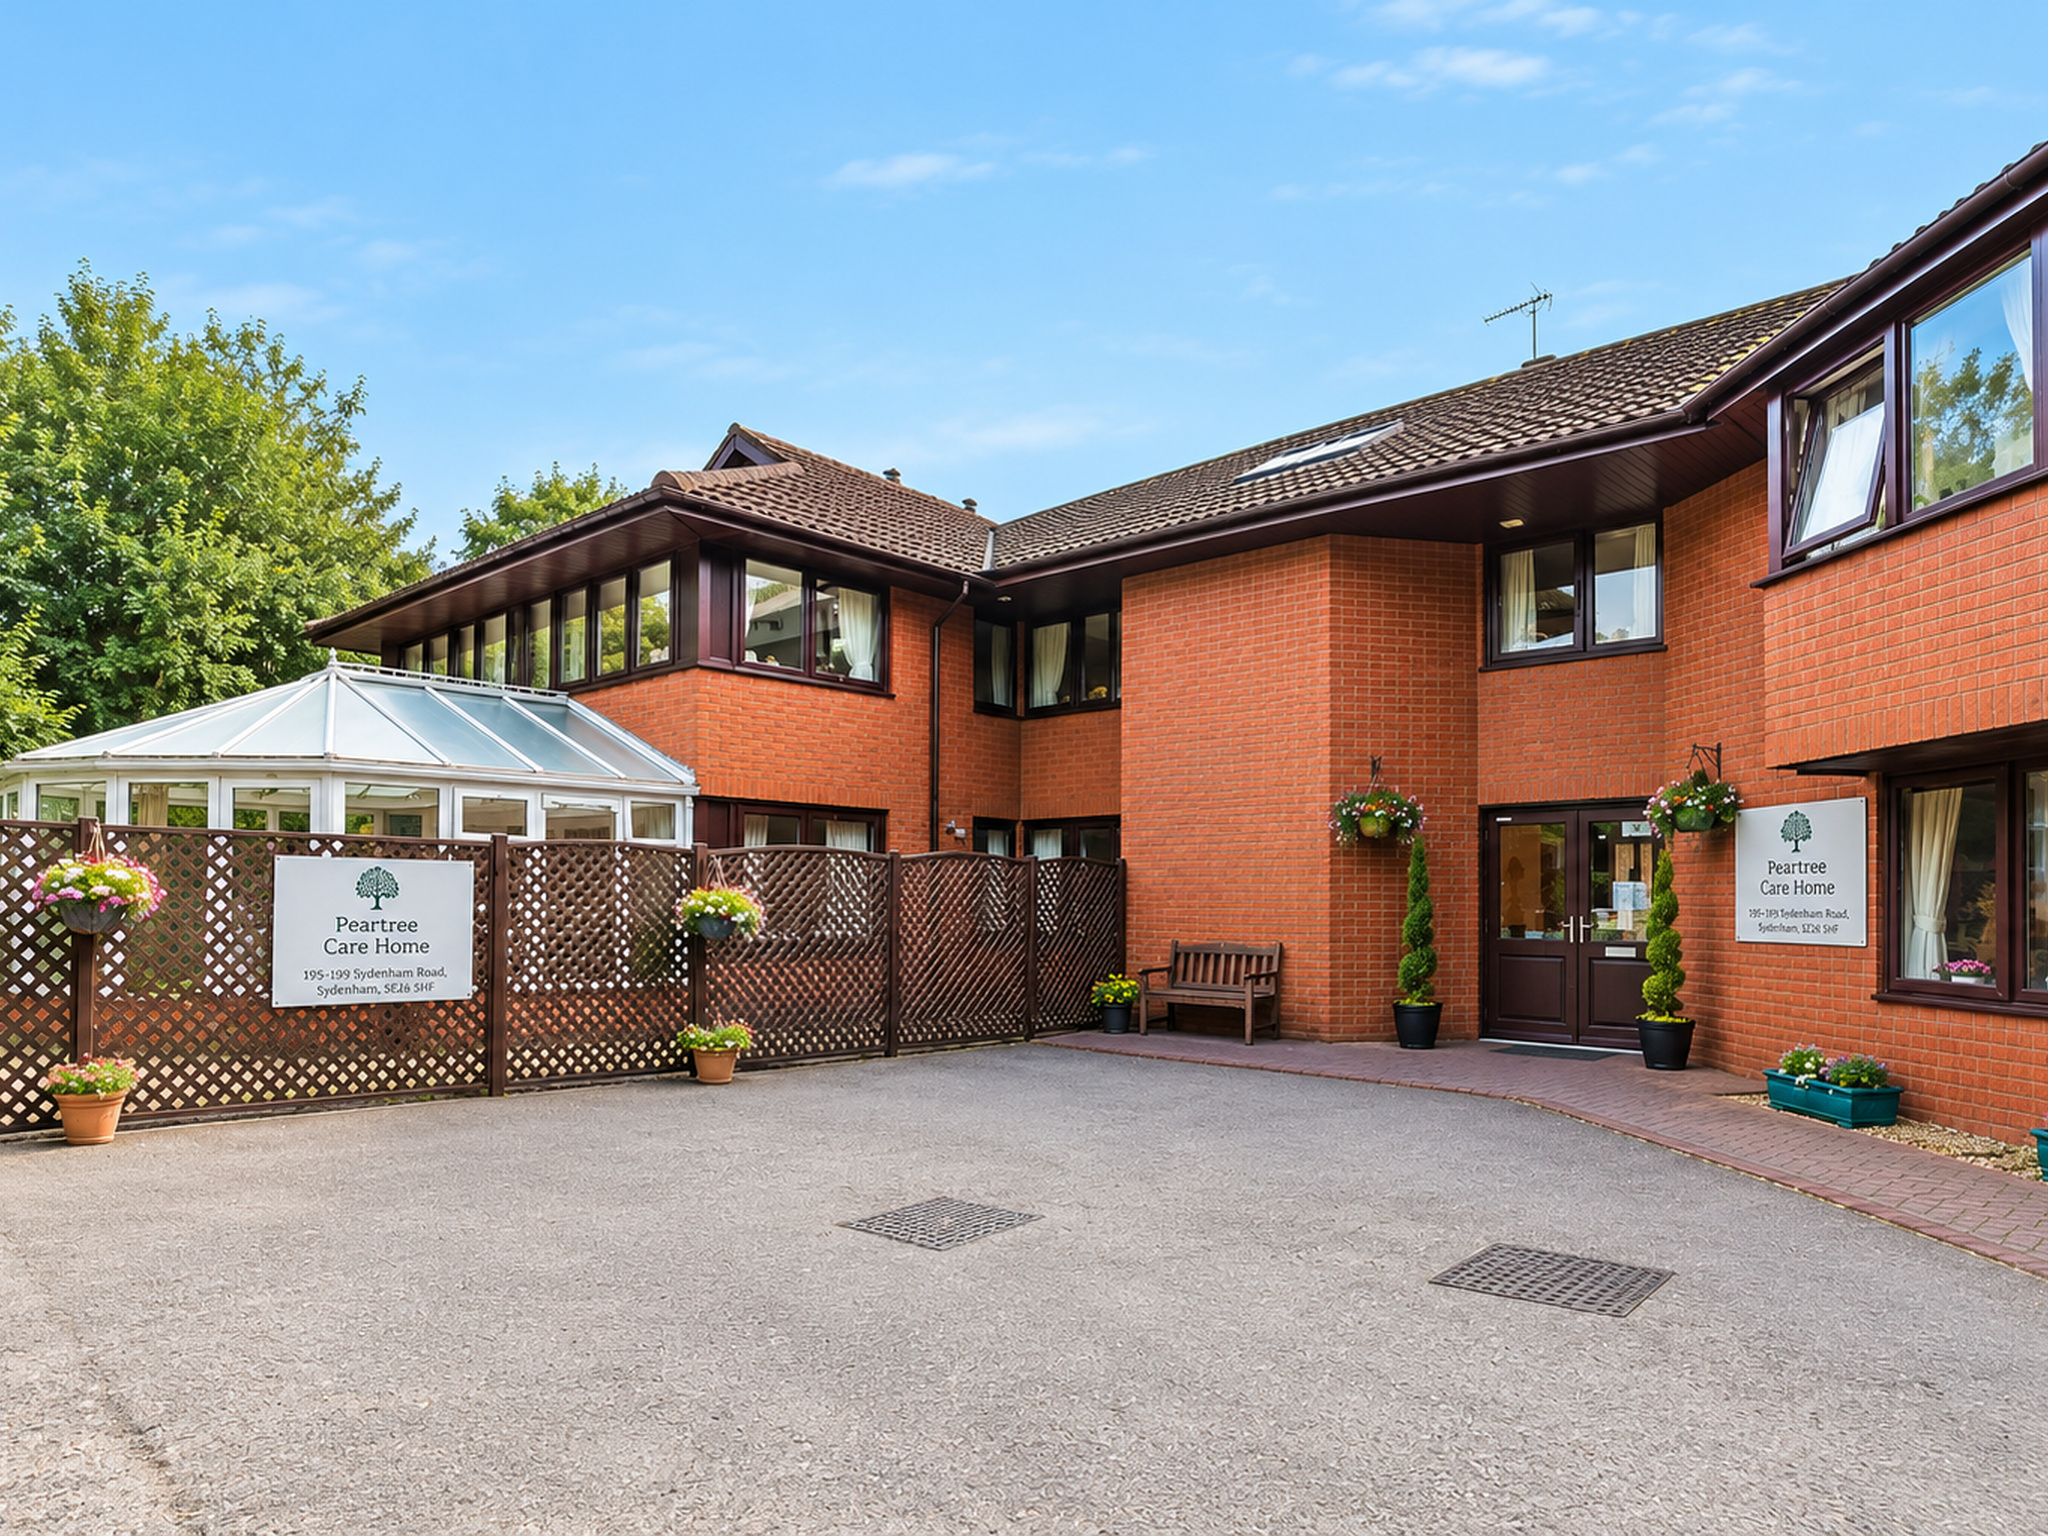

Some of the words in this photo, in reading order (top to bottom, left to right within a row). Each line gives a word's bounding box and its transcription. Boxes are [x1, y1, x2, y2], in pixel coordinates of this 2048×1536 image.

[1768, 860, 1827, 875] Peartree
[1760, 879, 1790, 895] Care
[1794, 879, 1835, 895] Home
[335, 916, 418, 933] Peartree
[323, 938, 369, 955] Care
[375, 938, 430, 955] Home
[303, 969, 350, 981] 195-199
[353, 967, 413, 982] Sydenham
[416, 966, 448, 978] Road,
[316, 984, 381, 999] Sydenham,
